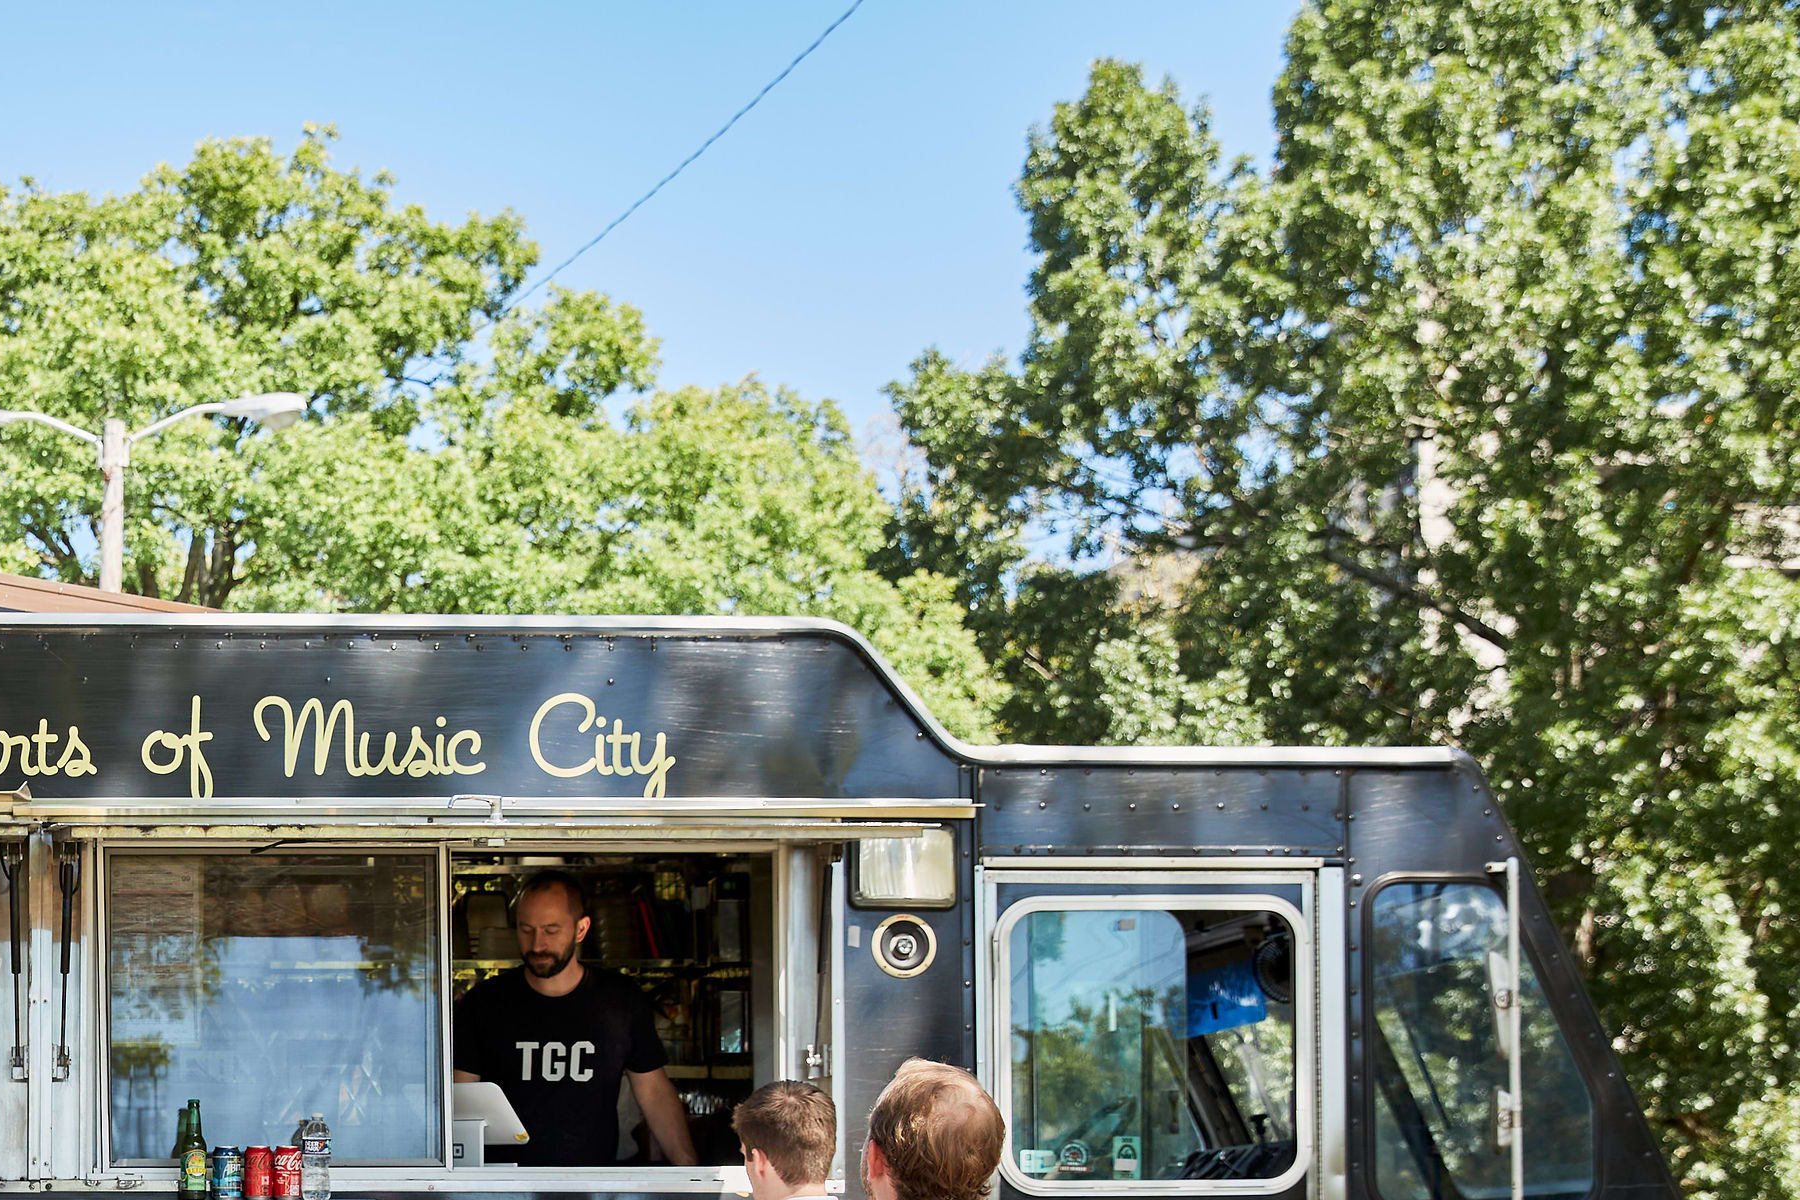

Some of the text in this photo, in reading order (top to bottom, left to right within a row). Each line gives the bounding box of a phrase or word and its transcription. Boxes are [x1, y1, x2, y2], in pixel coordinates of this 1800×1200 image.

[141, 695, 213, 799] of
[254, 694, 487, 777] Music
[528, 692, 676, 799] City
[515, 1040, 596, 1082] TGC
